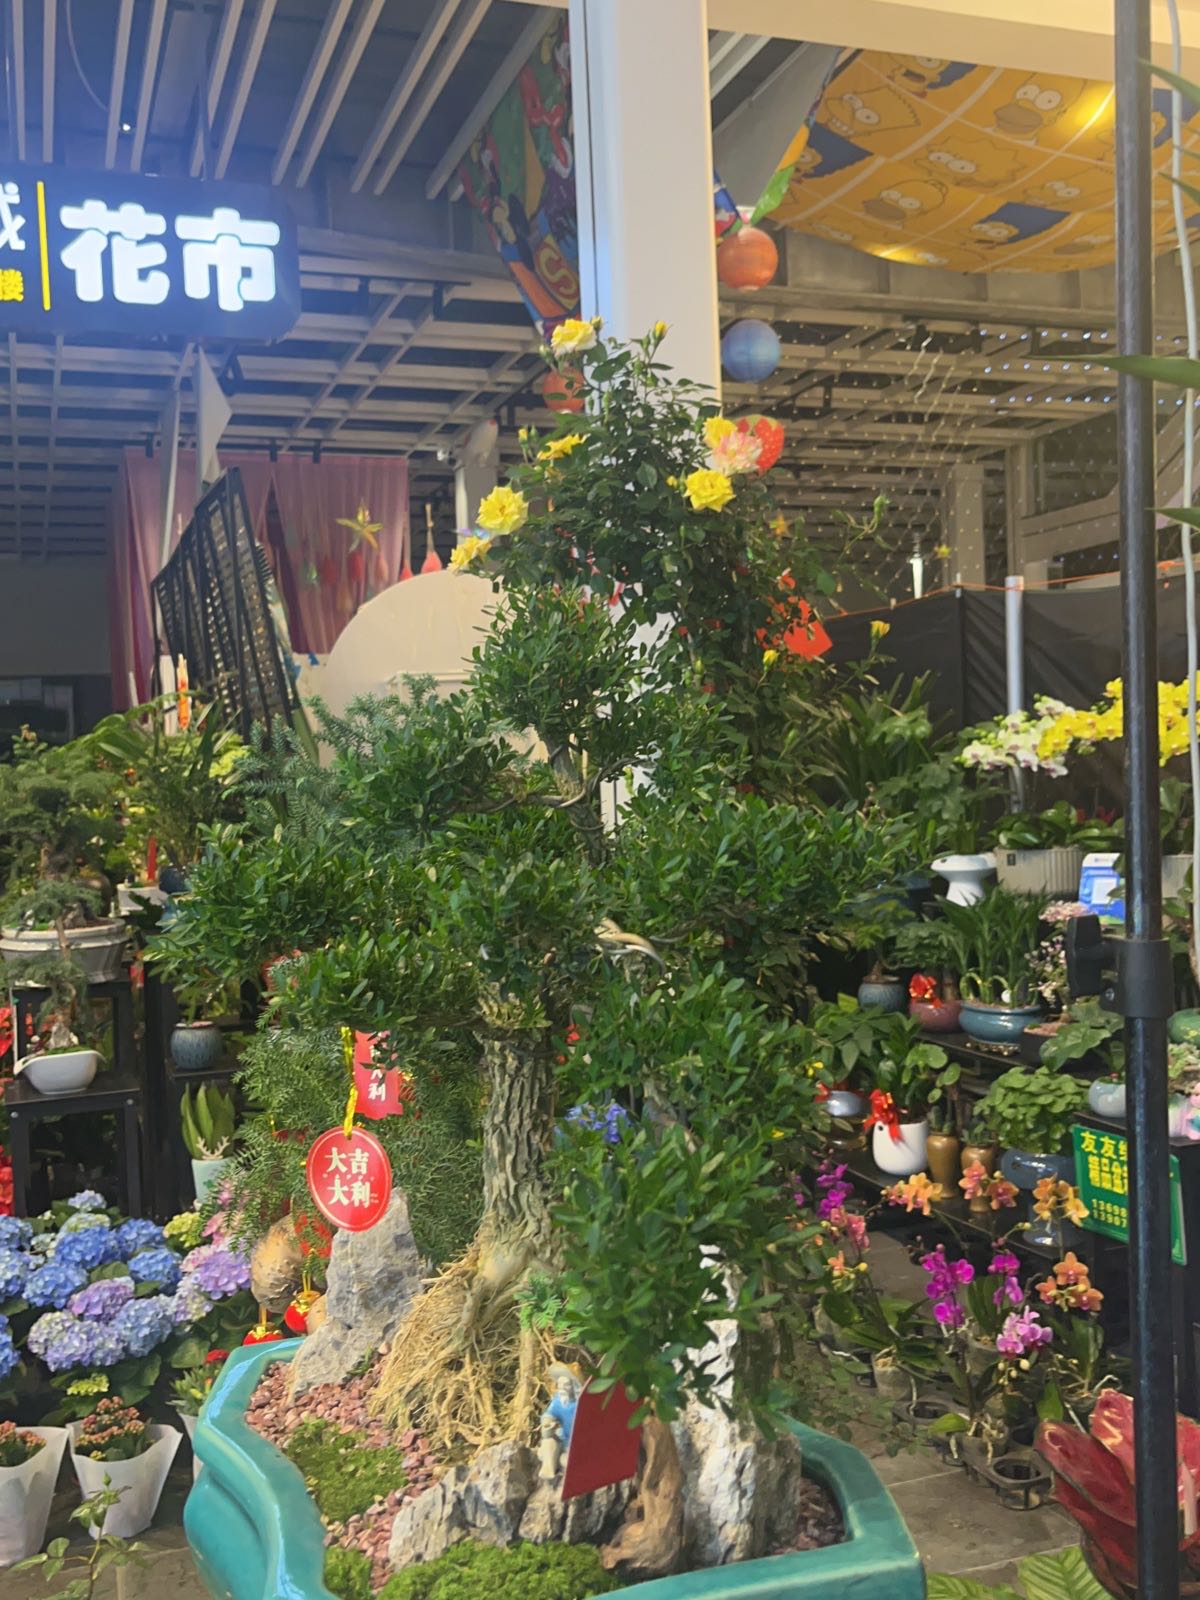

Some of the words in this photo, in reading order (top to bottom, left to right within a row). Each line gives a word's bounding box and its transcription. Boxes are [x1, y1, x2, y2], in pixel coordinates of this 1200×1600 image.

[60, 199, 280, 312] 花市
[324, 1147, 370, 1175] 大吉
[327, 1174, 371, 1209] 大利
